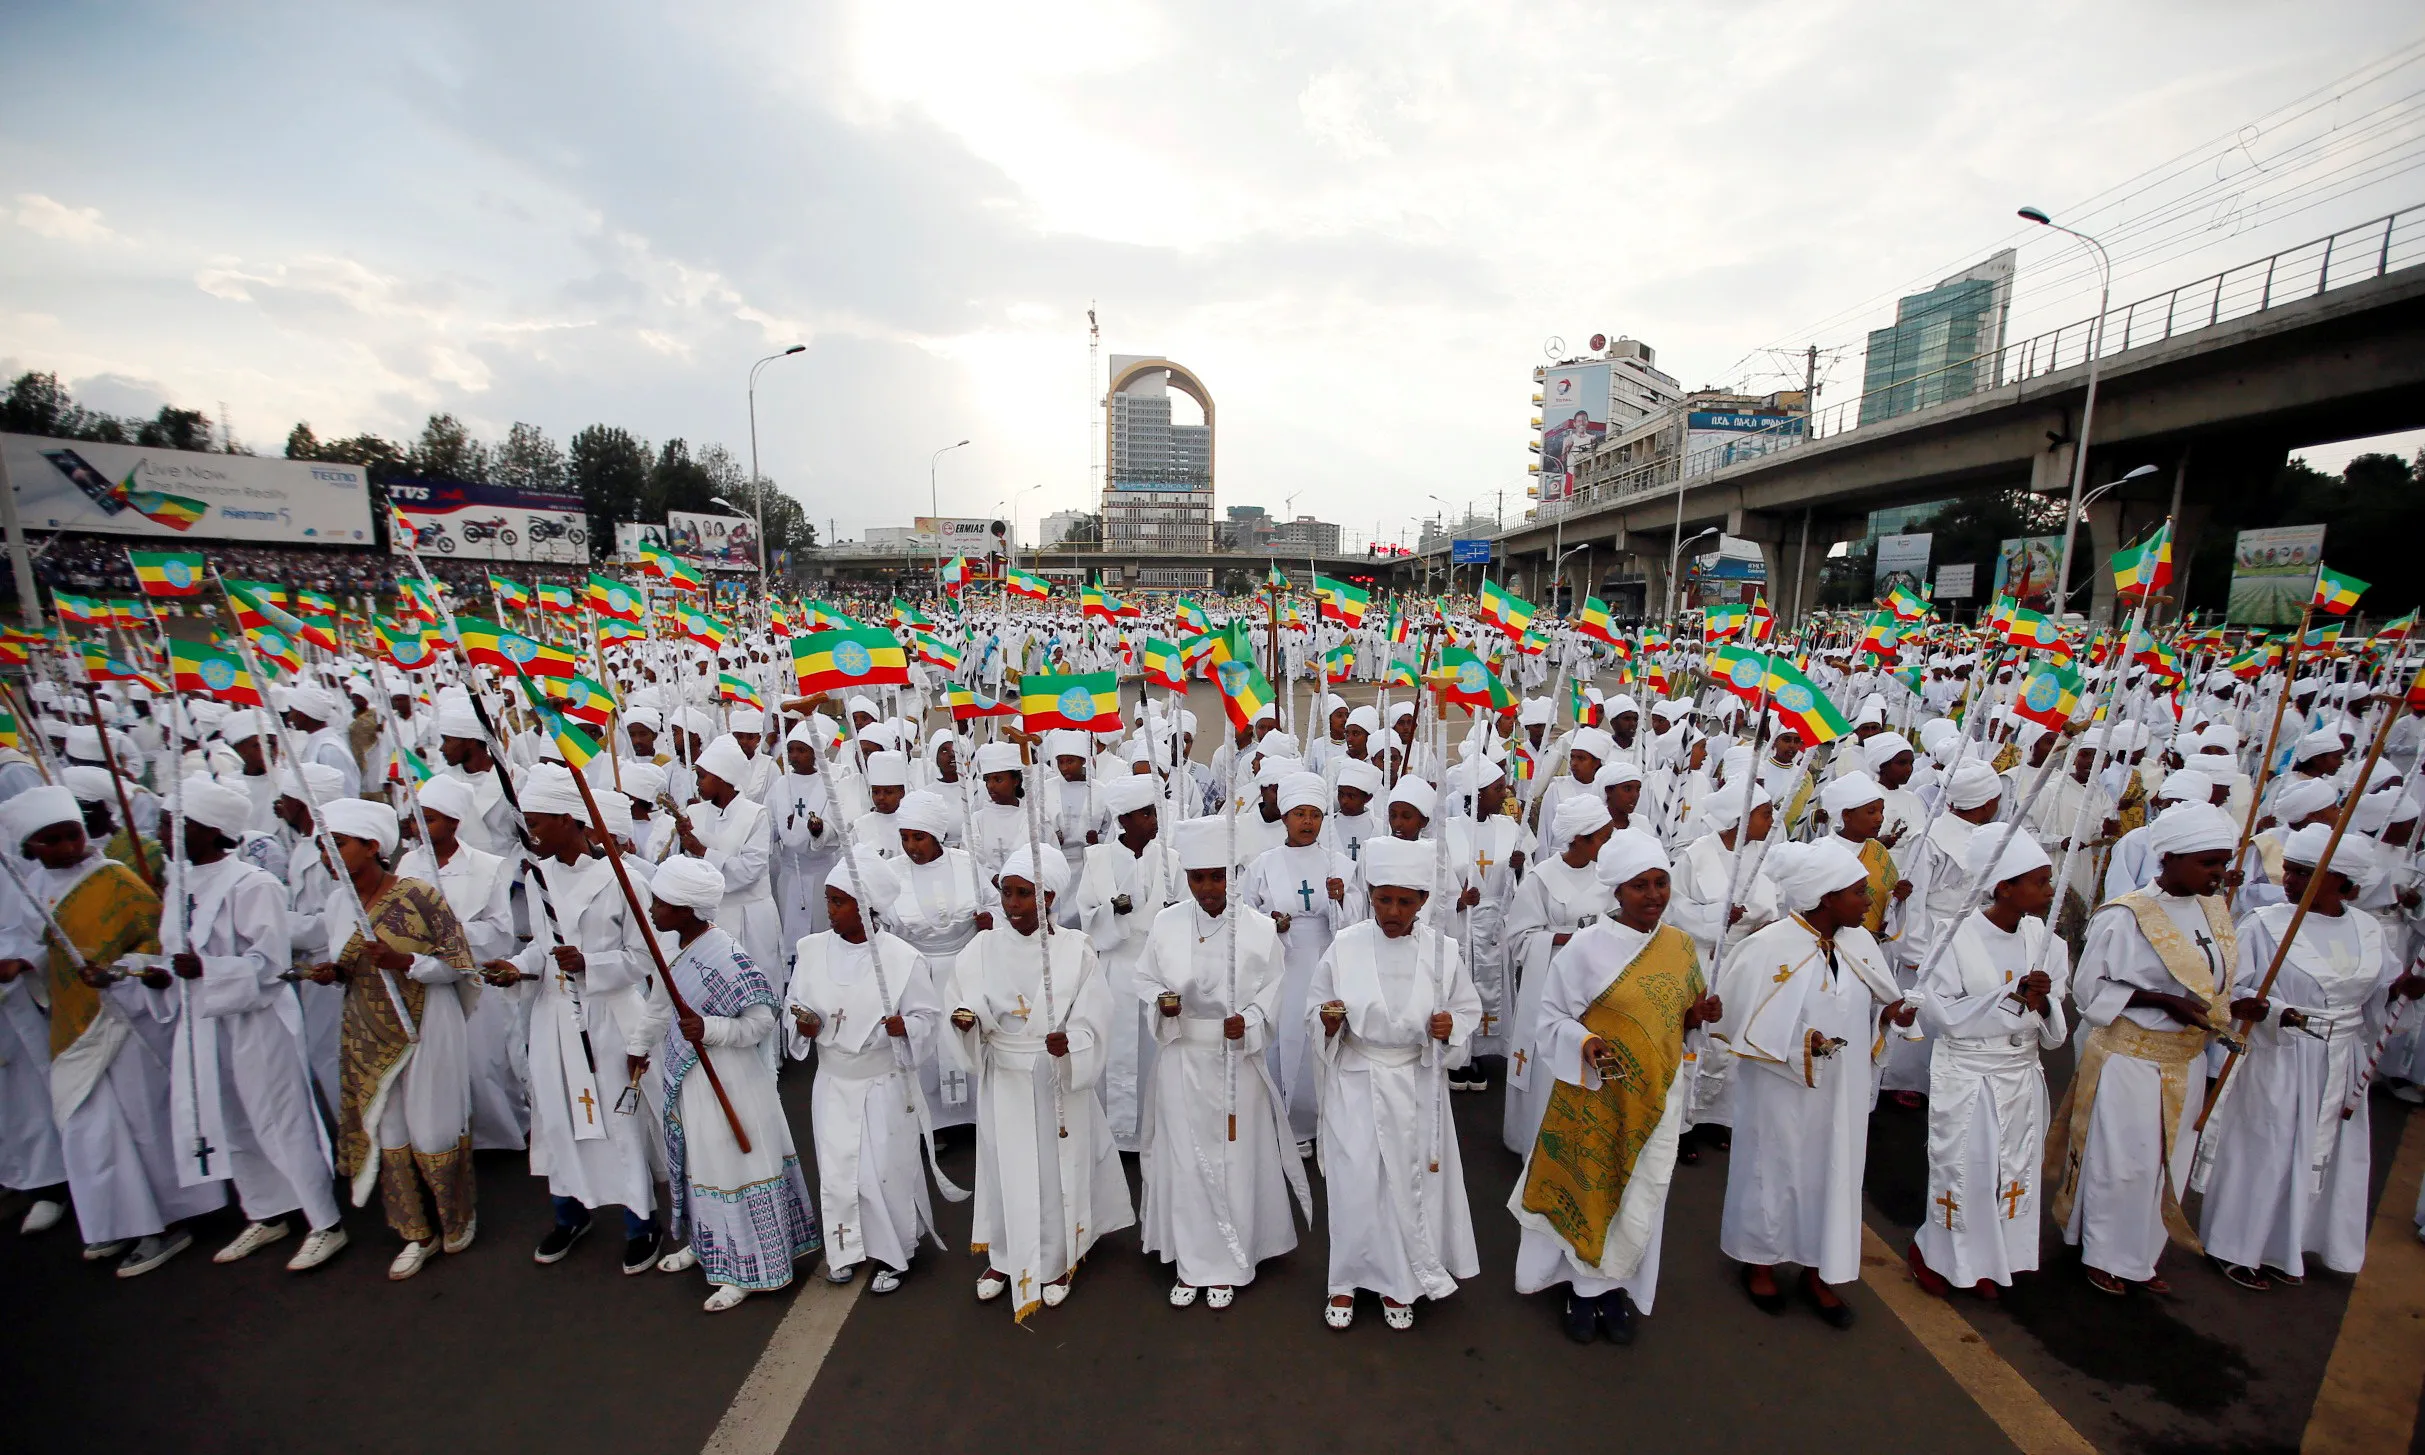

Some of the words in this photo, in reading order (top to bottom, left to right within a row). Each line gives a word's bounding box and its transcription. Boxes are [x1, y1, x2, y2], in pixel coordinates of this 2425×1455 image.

[144, 462, 181, 477] Live
[388, 485, 430, 500] TVS
[955, 523, 985, 534] ERMIAS
